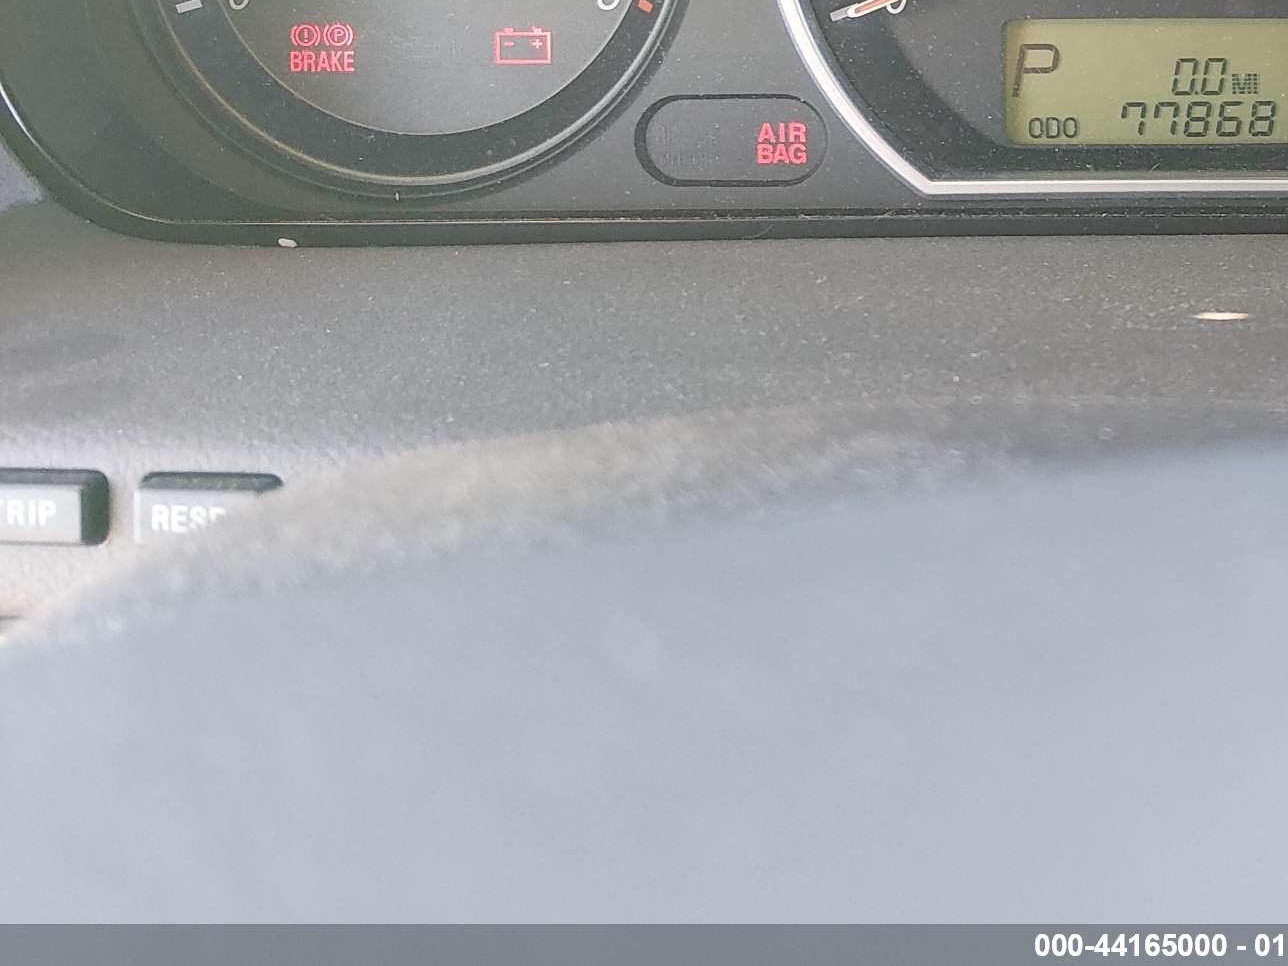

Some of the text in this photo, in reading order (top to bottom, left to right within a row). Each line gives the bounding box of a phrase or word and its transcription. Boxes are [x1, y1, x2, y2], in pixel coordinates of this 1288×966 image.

[290, 51, 354, 72] BRAKE
[1012, 43, 1060, 98] P
[1172, 58, 1258, 95] 0.0 MI
[758, 122, 806, 144] AIR
[1029, 100, 1277, 138] ODO 77868
[758, 144, 806, 164] BAG
[0, 498, 57, 527] RIP
